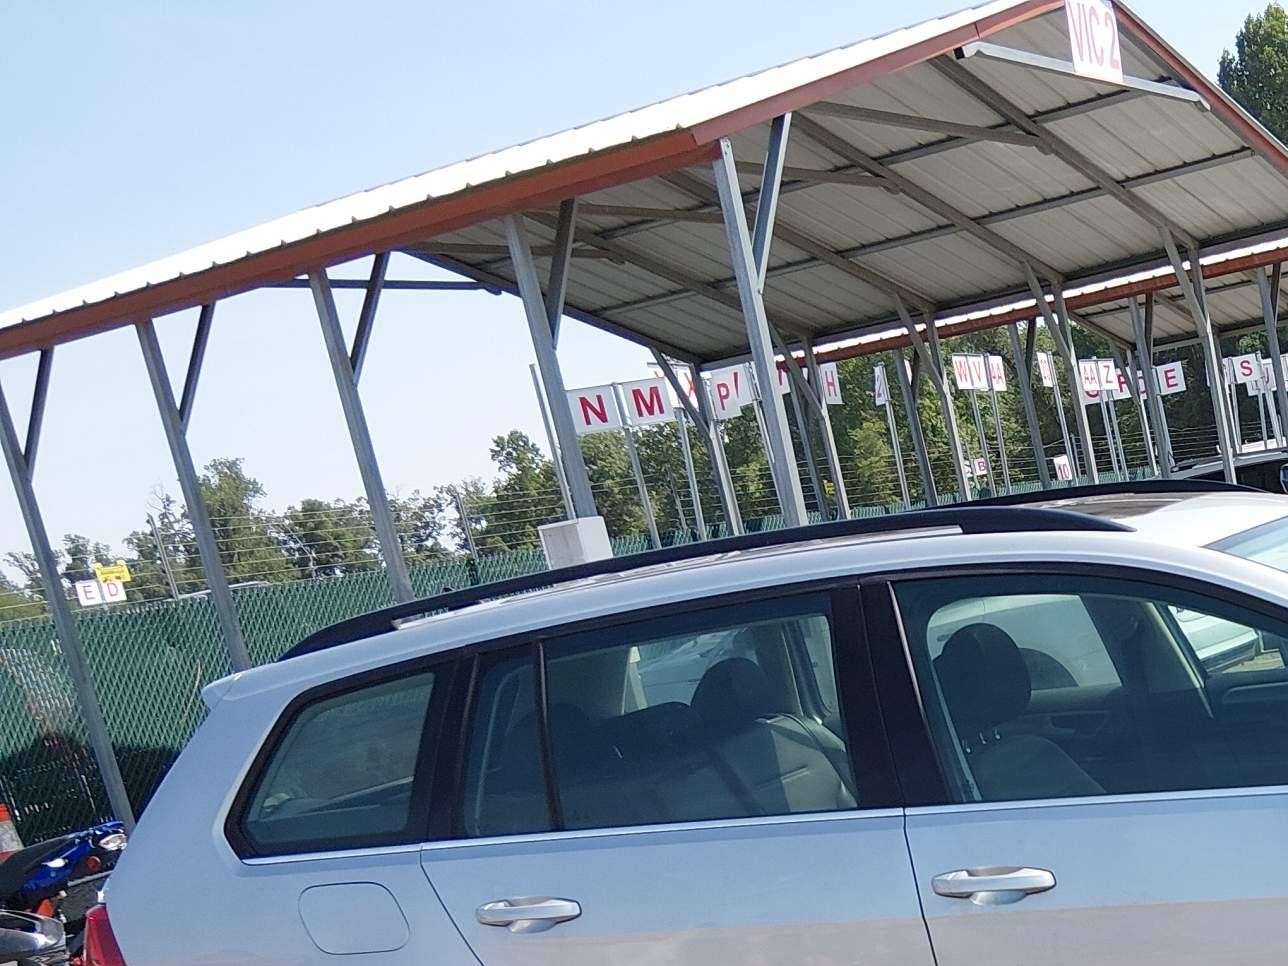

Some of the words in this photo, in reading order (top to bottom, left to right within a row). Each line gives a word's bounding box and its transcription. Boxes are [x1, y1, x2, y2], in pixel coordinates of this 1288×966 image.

[1103, 364, 1114, 384] Z
[1240, 360, 1253, 377] S
[825, 370, 838, 397] H
[1163, 369, 1179, 389] E
[579, 394, 609, 426] N
[631, 386, 665, 418] M
[82, 584, 96, 601] E
[106, 582, 119, 597] D
